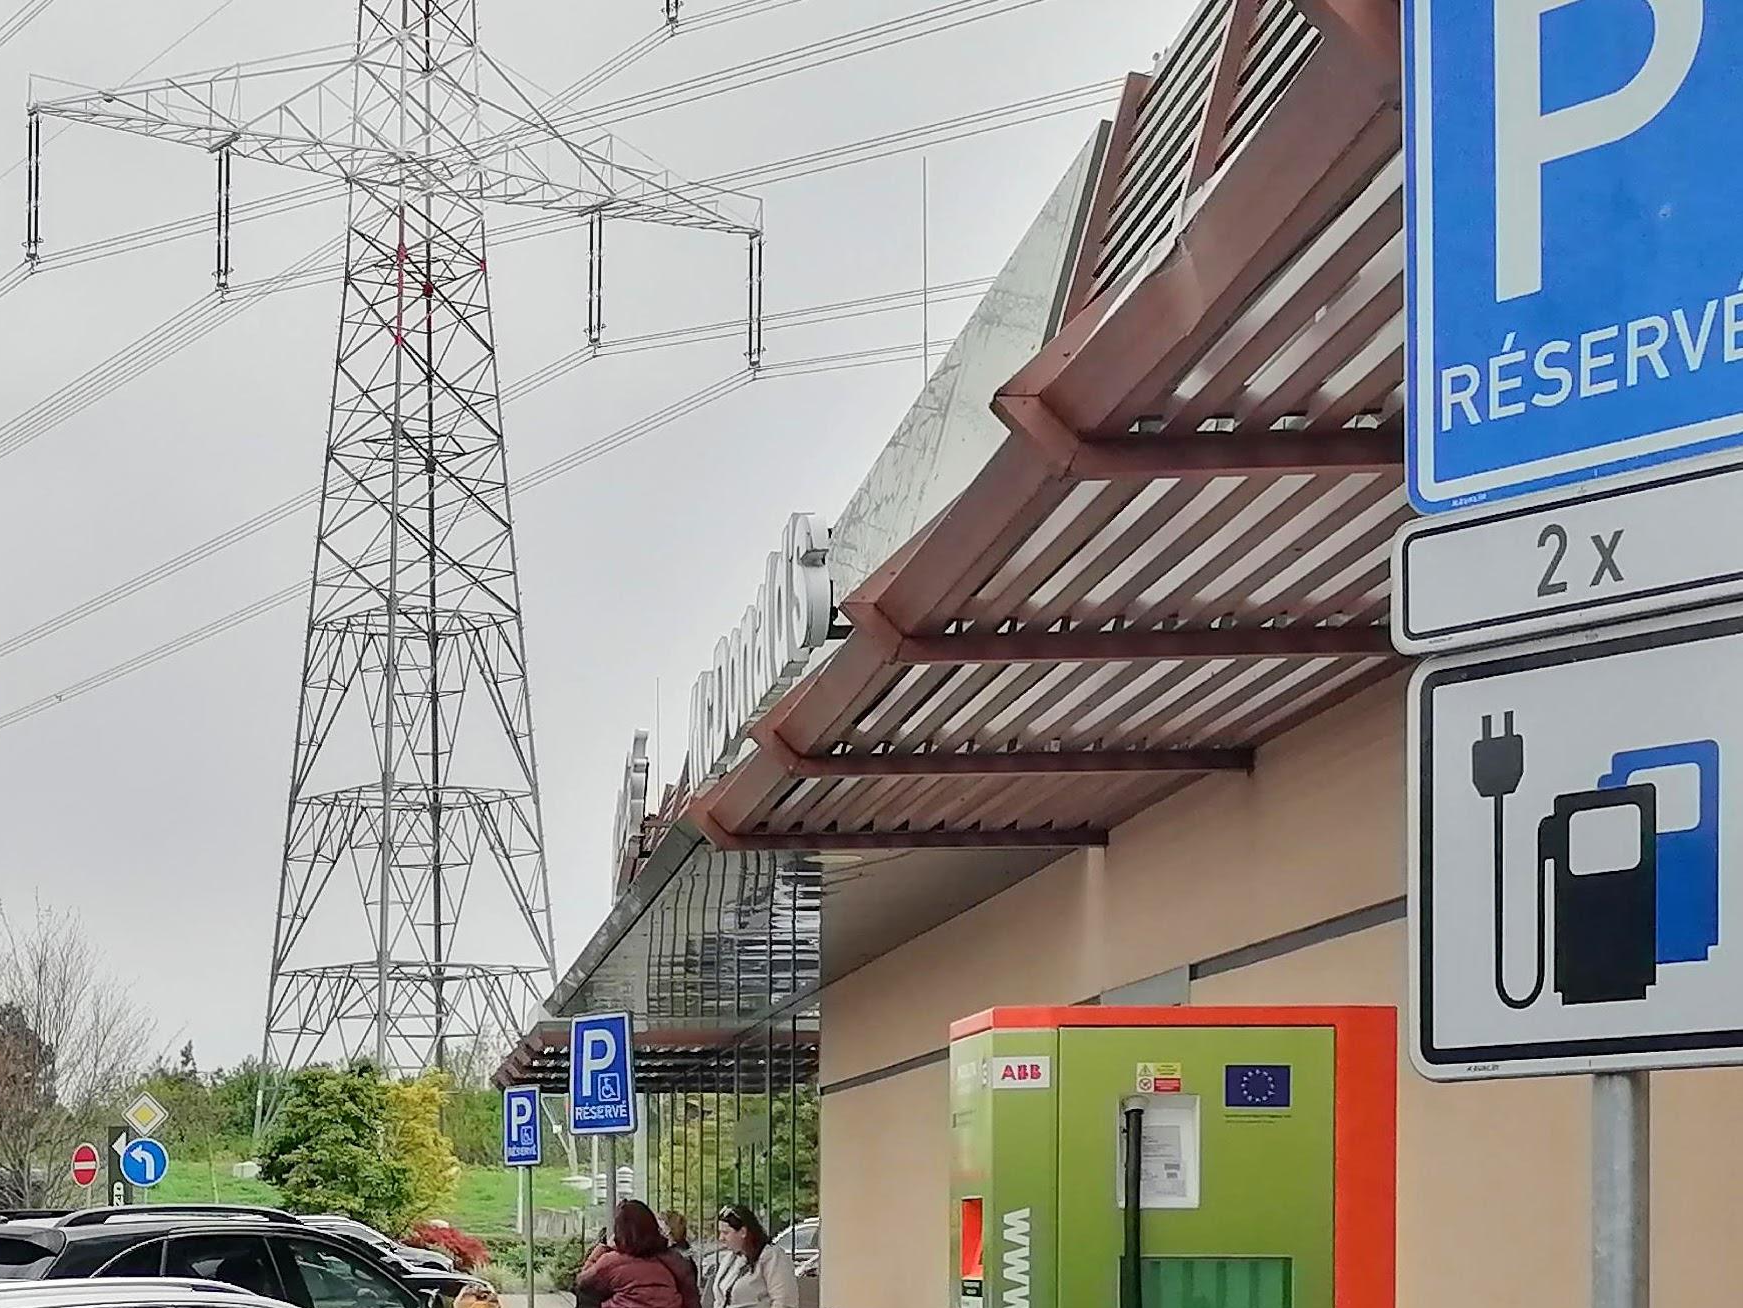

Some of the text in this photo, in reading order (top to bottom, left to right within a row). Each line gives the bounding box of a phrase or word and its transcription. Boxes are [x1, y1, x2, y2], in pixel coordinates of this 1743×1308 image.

[1493, 0, 1704, 303] P
[1536, 523, 1568, 597] 2
[582, 1028, 616, 1097] P
[1001, 1064, 1042, 1080] ABB
[511, 1096, 533, 1142] P
[575, 1099, 628, 1121] RÉSERVÉ
